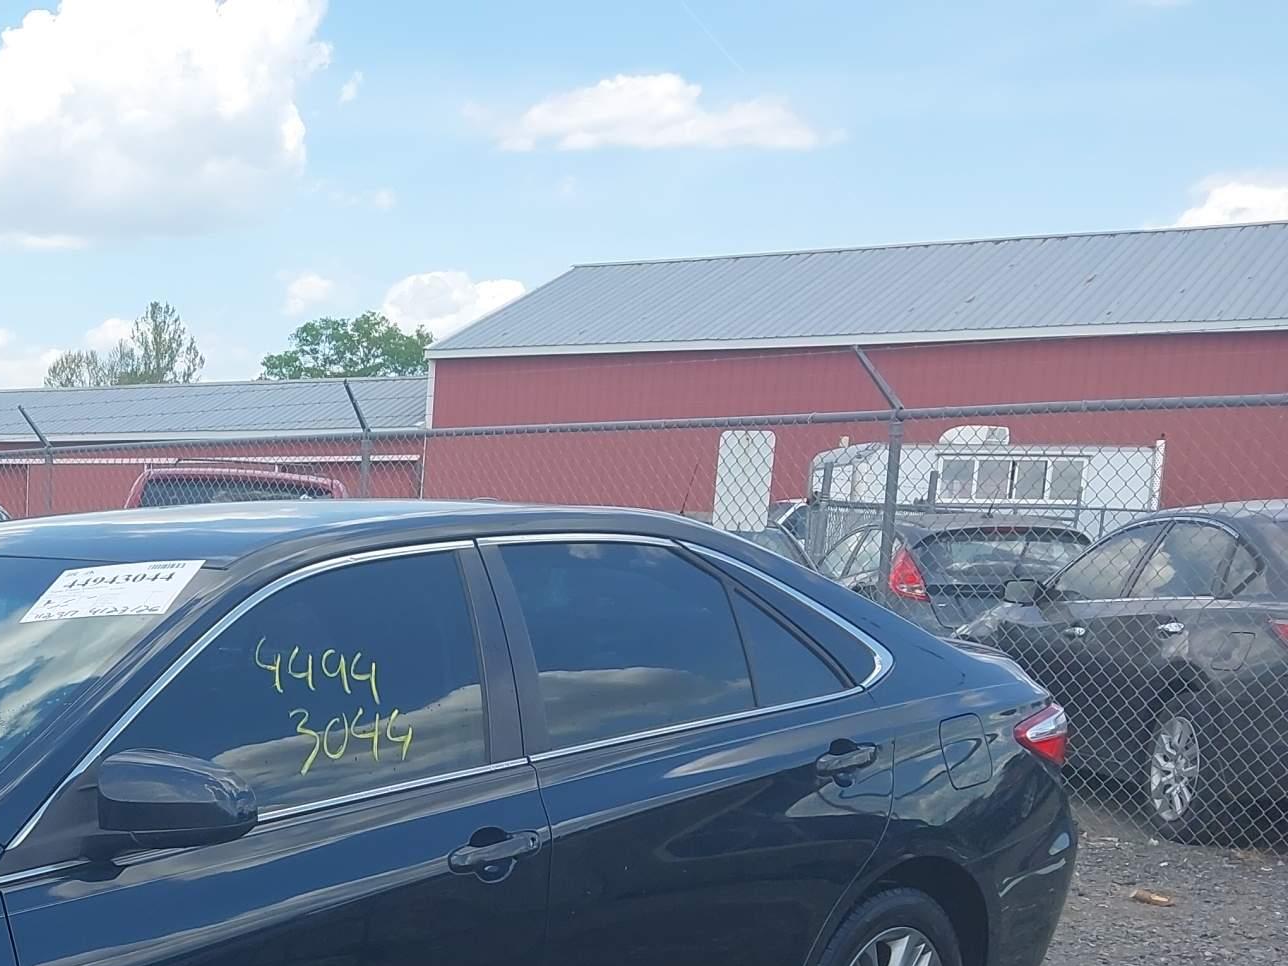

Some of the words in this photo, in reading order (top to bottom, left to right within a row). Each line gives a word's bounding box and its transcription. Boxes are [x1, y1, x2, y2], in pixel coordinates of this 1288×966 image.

[64, 571, 176, 589] 44943044
[255, 634, 380, 704] 4494
[288, 706, 413, 777] 3044
